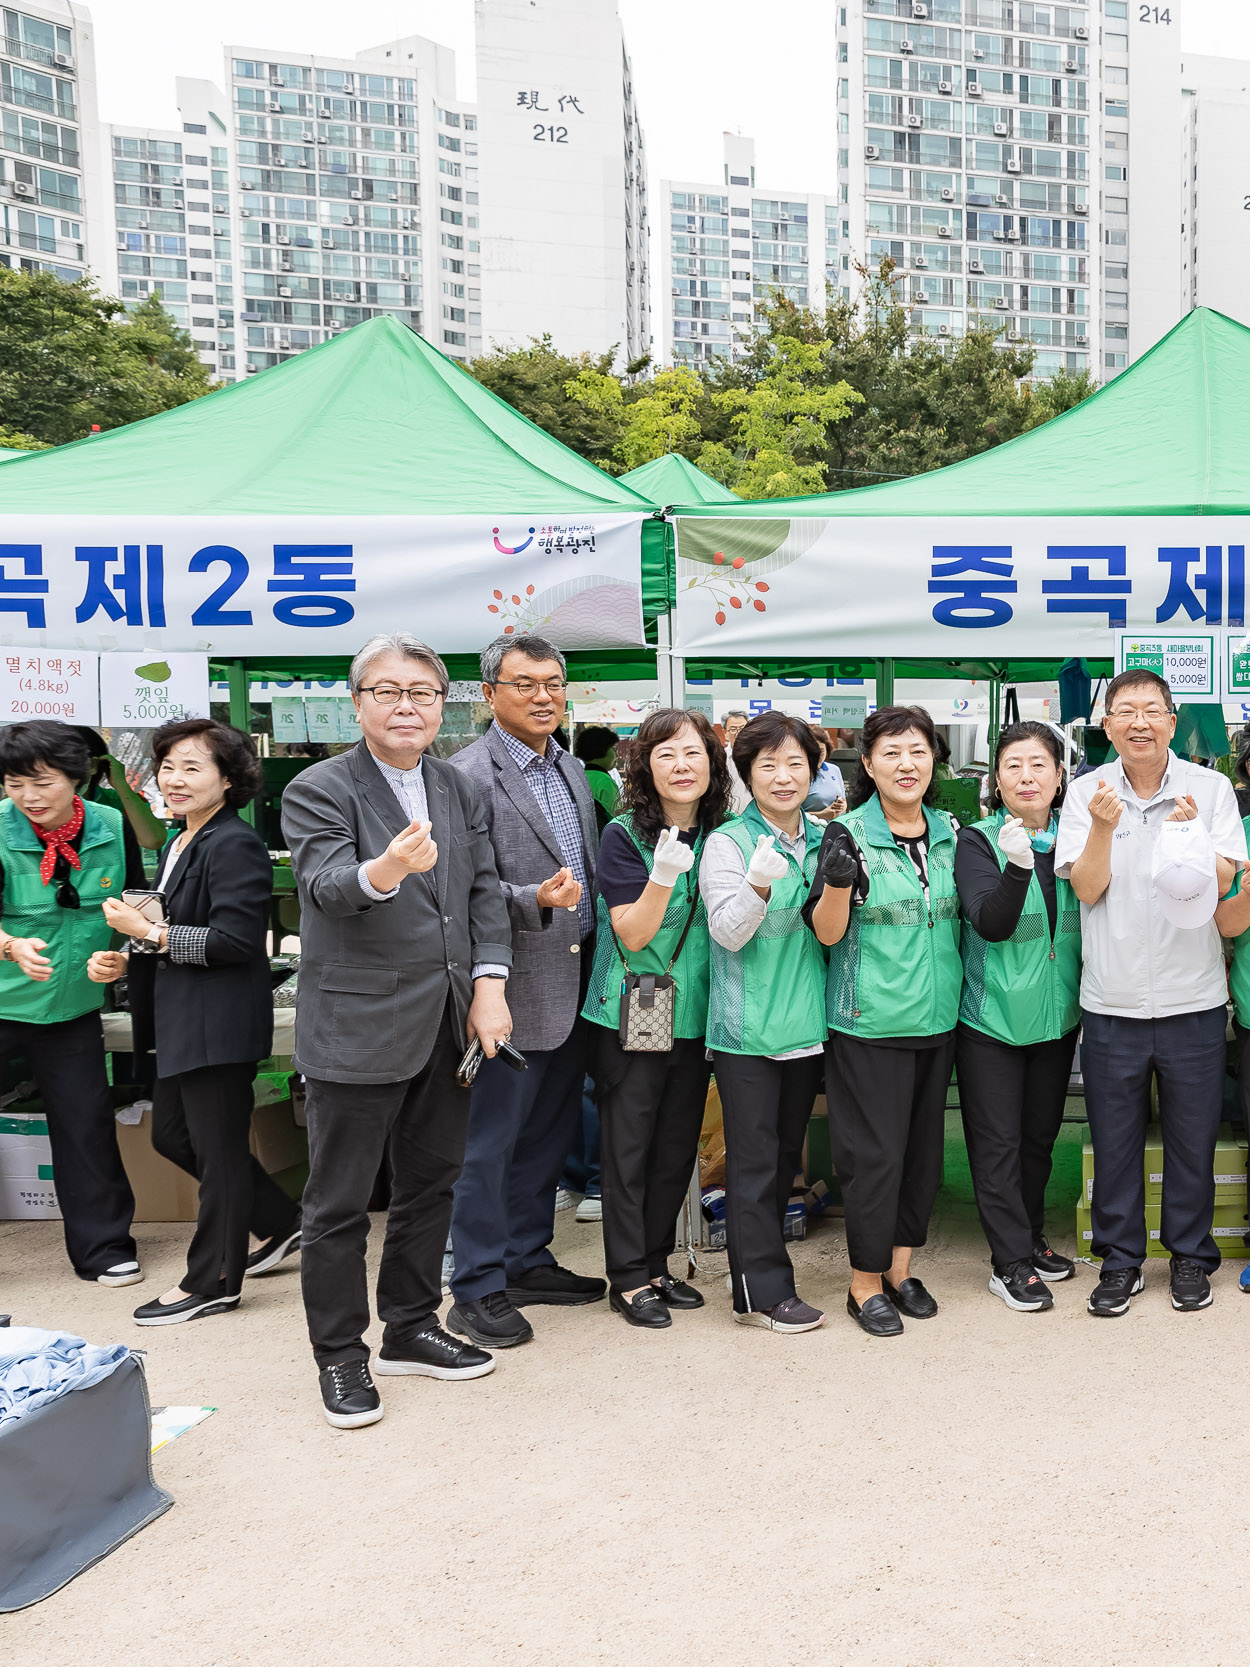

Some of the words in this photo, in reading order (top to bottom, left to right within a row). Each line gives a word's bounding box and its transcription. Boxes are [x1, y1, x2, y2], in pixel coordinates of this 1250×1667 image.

[1139, 5, 1172, 25] 214
[516, 90, 584, 114] 現代
[533, 124, 568, 143] 212
[538, 535, 596, 555] 행복광진
[5, 656, 82, 677] 멸치액젓
[1165, 657, 1207, 669] 10,000원
[19, 678, 69, 694] (4.8kg)
[1170, 674, 1206, 686] 5,000원
[134, 686, 170, 703] 깻잎
[11, 700, 75, 718] 20,000원
